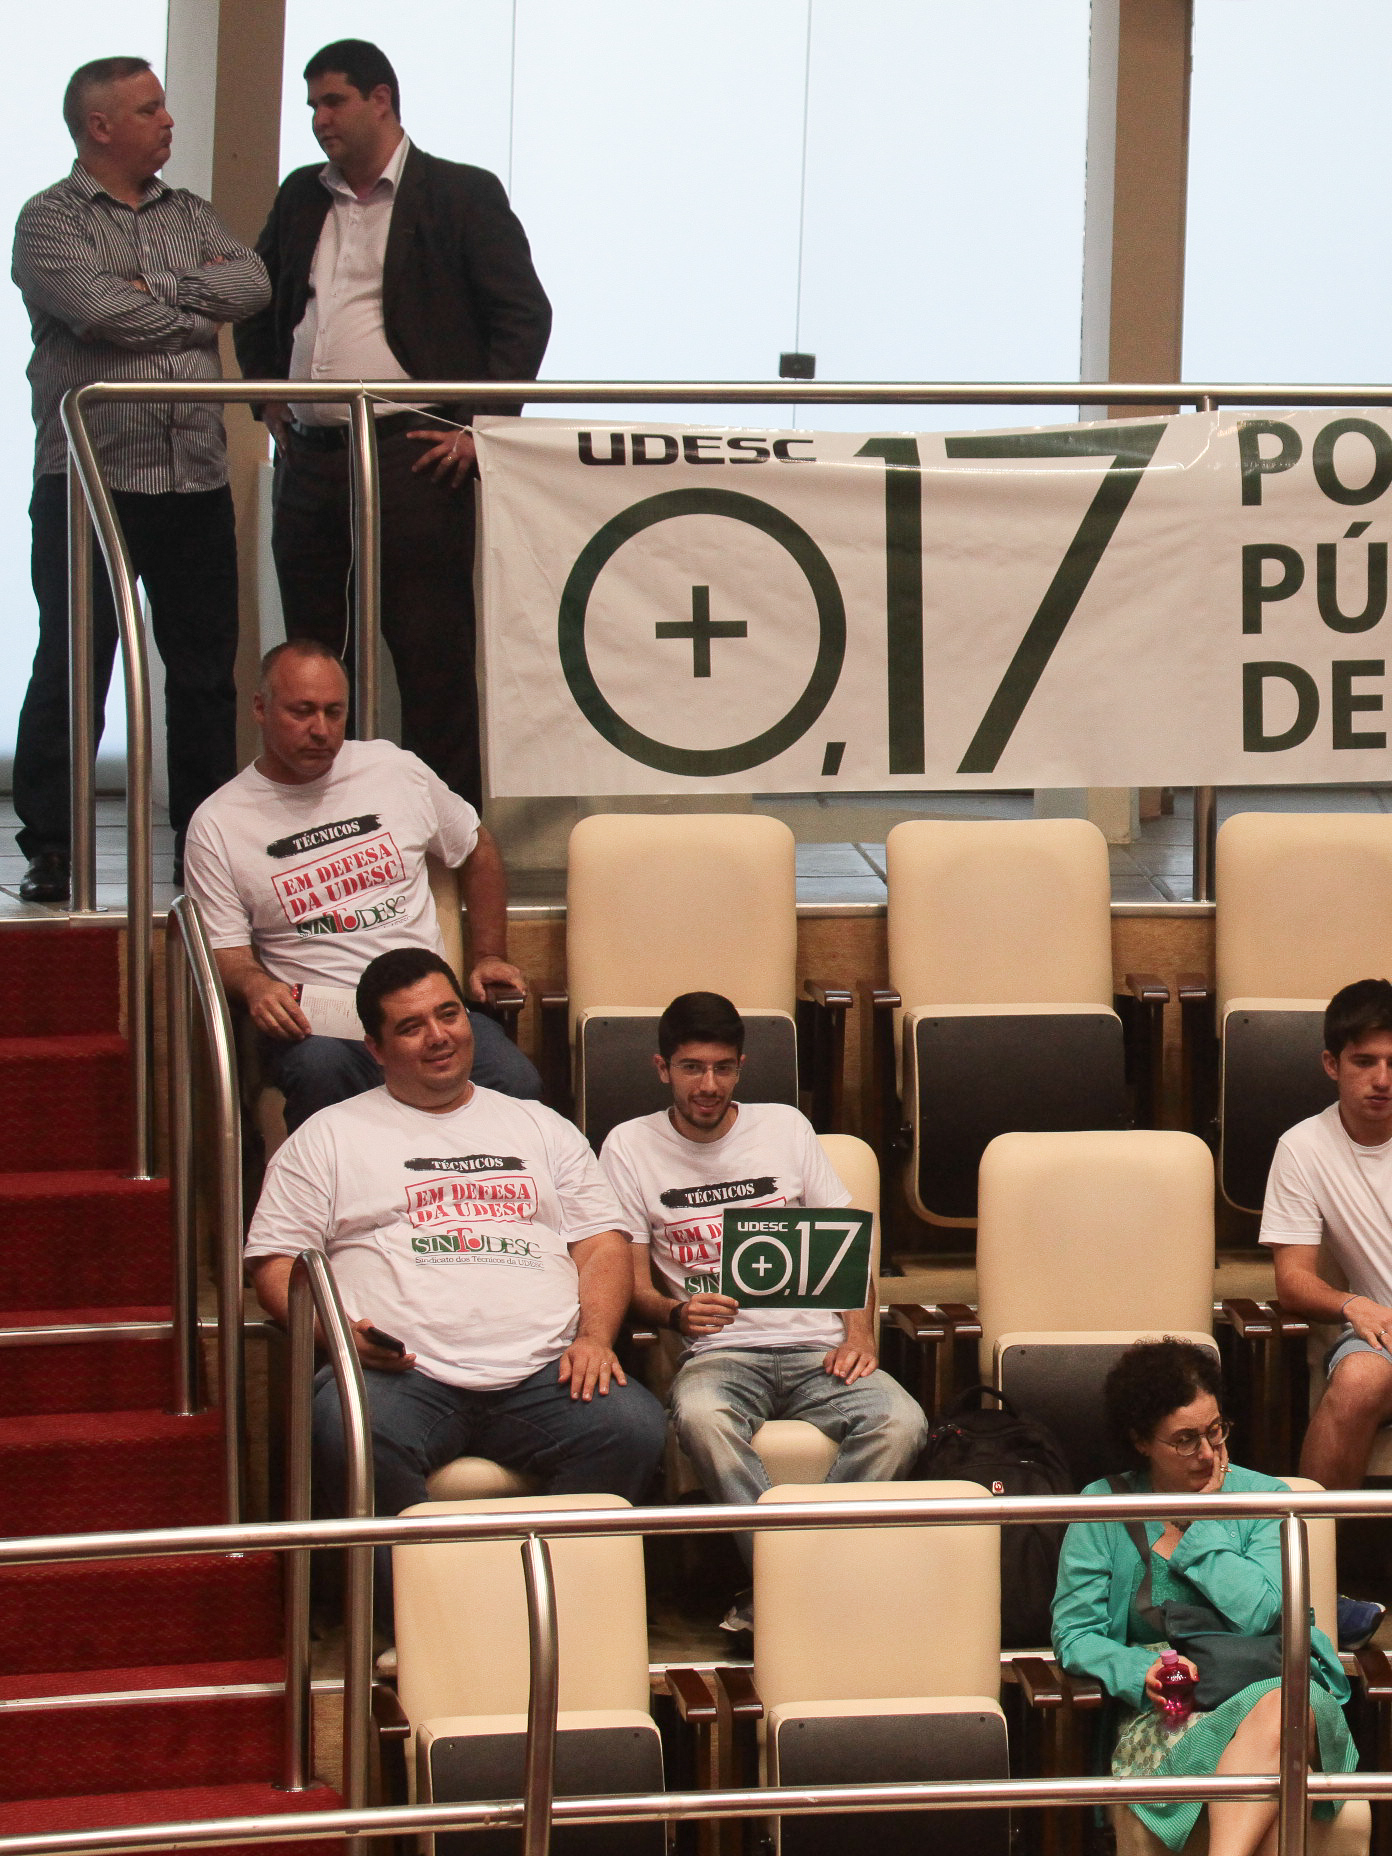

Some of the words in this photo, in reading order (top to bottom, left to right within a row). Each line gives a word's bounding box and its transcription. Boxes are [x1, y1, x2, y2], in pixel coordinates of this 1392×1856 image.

[577, 431, 817, 466] UDESC
[1242, 658, 1387, 752] DE
[292, 820, 361, 851] TÉCNICOS
[281, 872, 314, 897] EM
[315, 843, 393, 884] DEFESA
[288, 892, 324, 918] DA
[324, 860, 399, 903] UDESC
[431, 1157, 504, 1171] TÉCNICOS
[415, 1187, 445, 1208] EM
[450, 1183, 531, 1201] DEFESA
[685, 1183, 755, 1205] TÉCNICOS
[416, 1205, 450, 1223] DA
[455, 1202, 532, 1219] UDESC
[671, 1226, 704, 1243] EM
[737, 1221, 788, 1232] UDESC
[506, 1257, 517, 1265] da
[678, 1243, 710, 1264] DA
